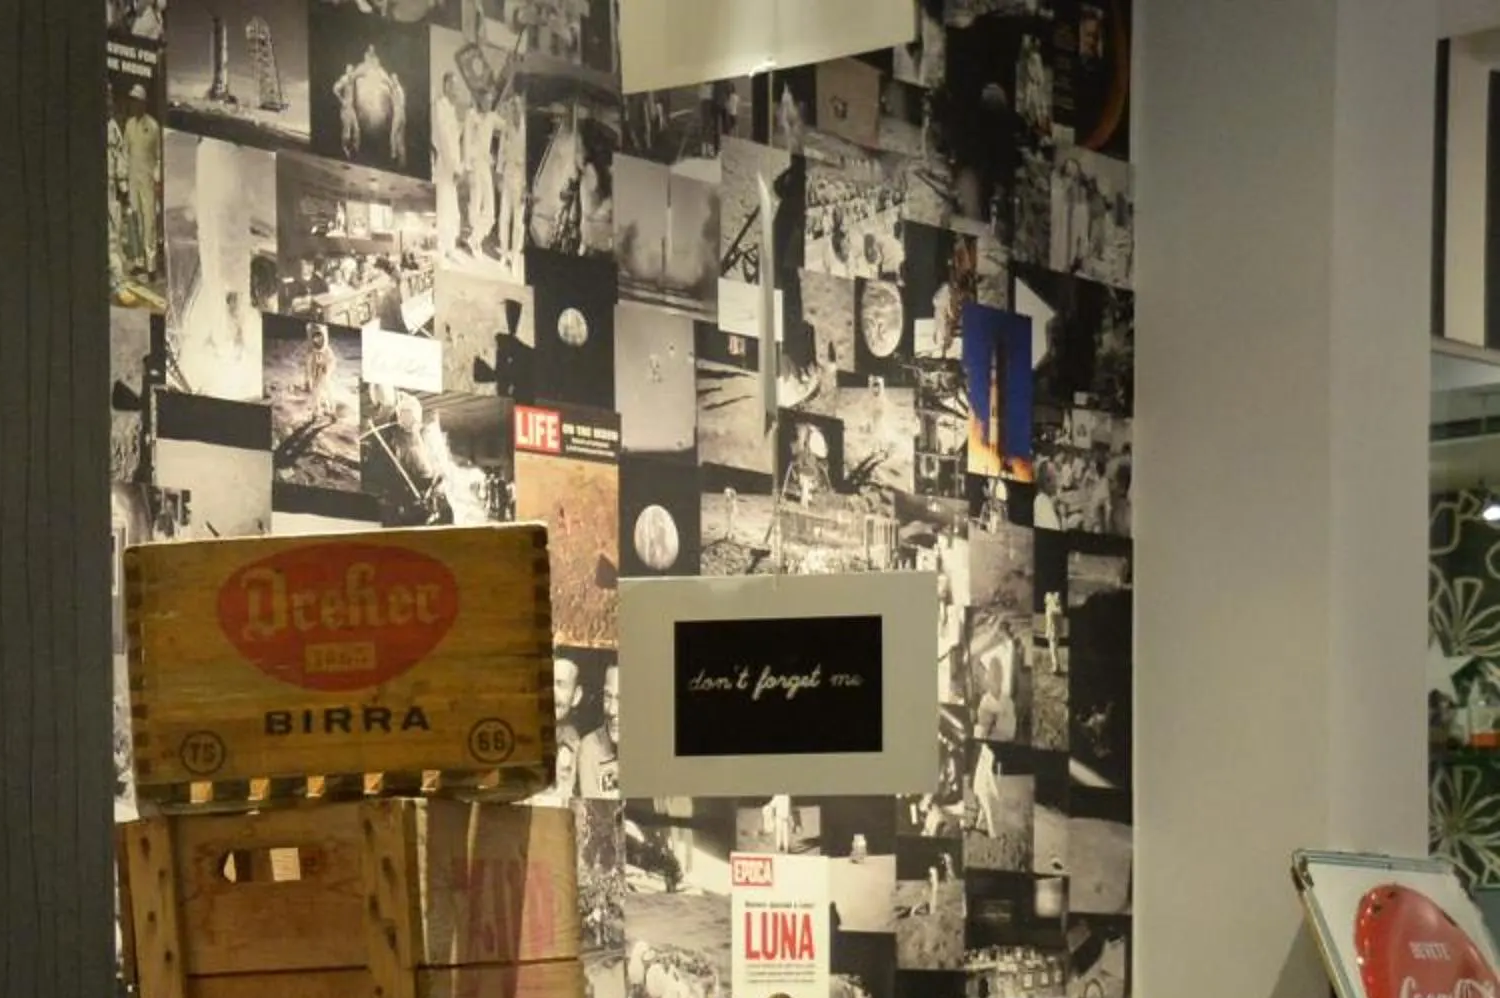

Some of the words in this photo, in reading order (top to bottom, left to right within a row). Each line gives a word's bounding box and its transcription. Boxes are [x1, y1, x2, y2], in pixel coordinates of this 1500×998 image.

[516, 411, 559, 449] LIFE
[241, 562, 442, 641] Dreher
[751, 664, 822, 702] forget
[264, 707, 431, 736] BIRRA
[744, 911, 815, 961] LUNA
